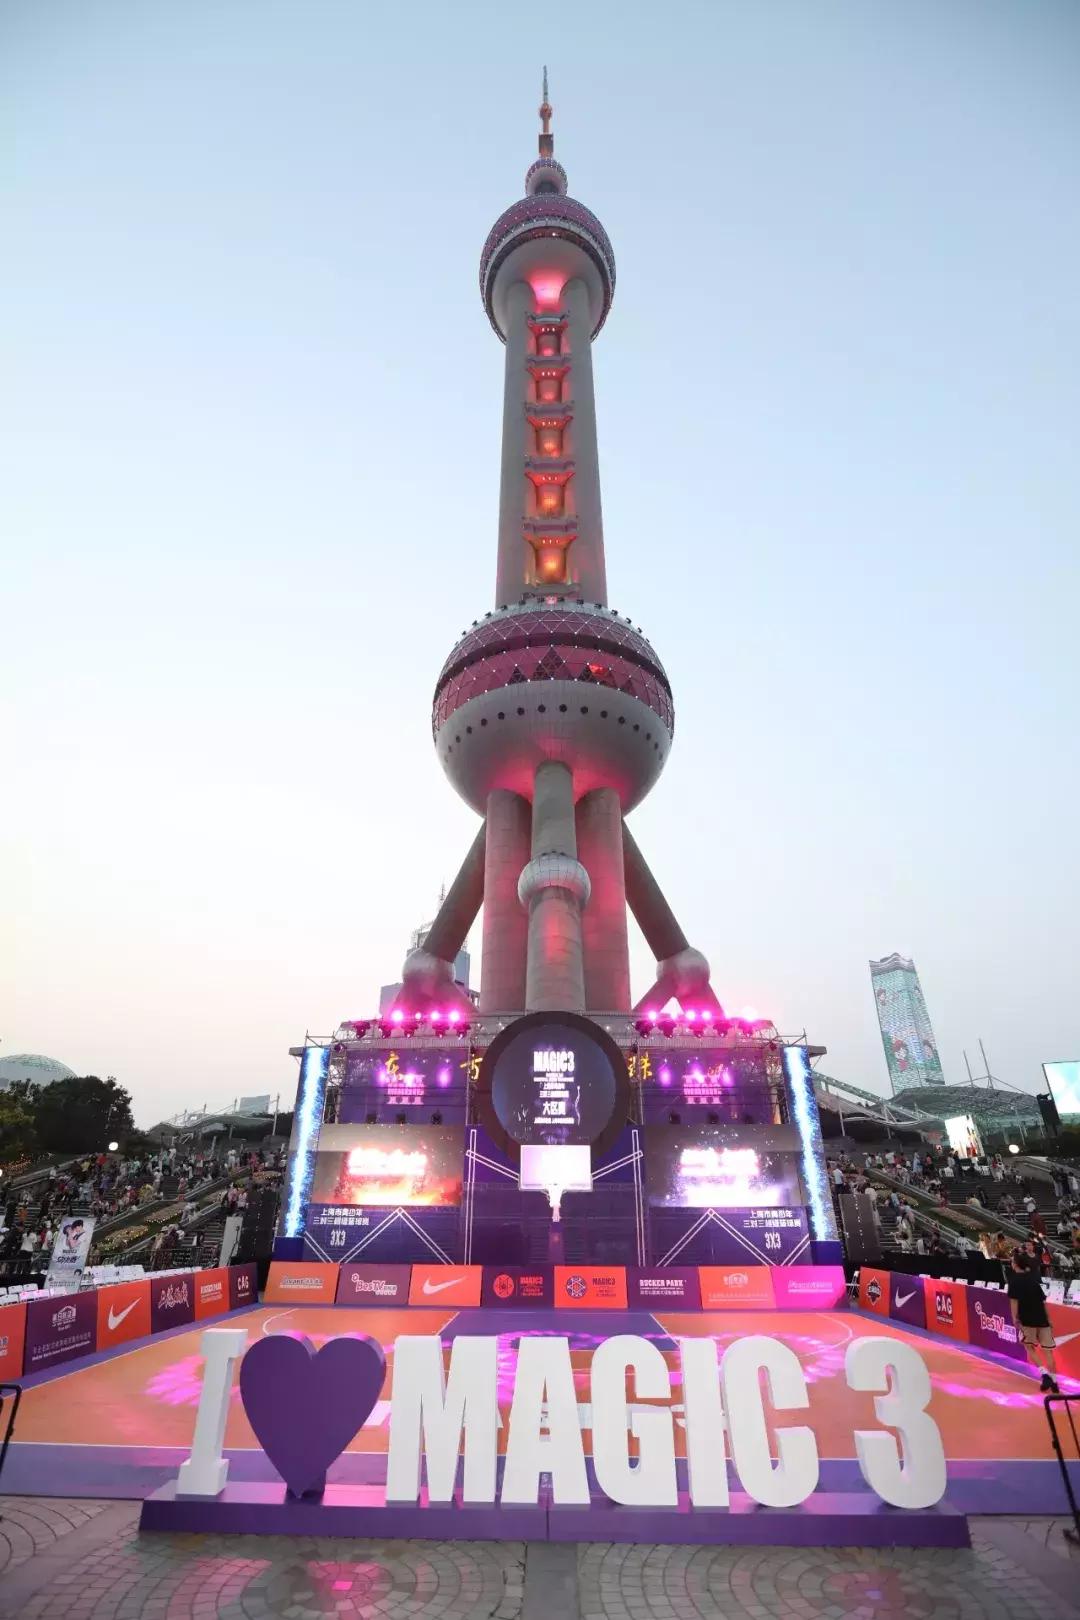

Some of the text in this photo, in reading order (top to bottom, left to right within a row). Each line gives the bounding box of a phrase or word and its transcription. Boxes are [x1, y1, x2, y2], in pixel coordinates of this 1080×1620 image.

[533, 1050, 575, 1072] MAGIC3
[764, 1231, 781, 1250] 3X3
[237, 1275, 249, 1291] CAG
[936, 1295, 953, 1315] CAG
[177, 1328, 947, 1510] I MAGIC 3
